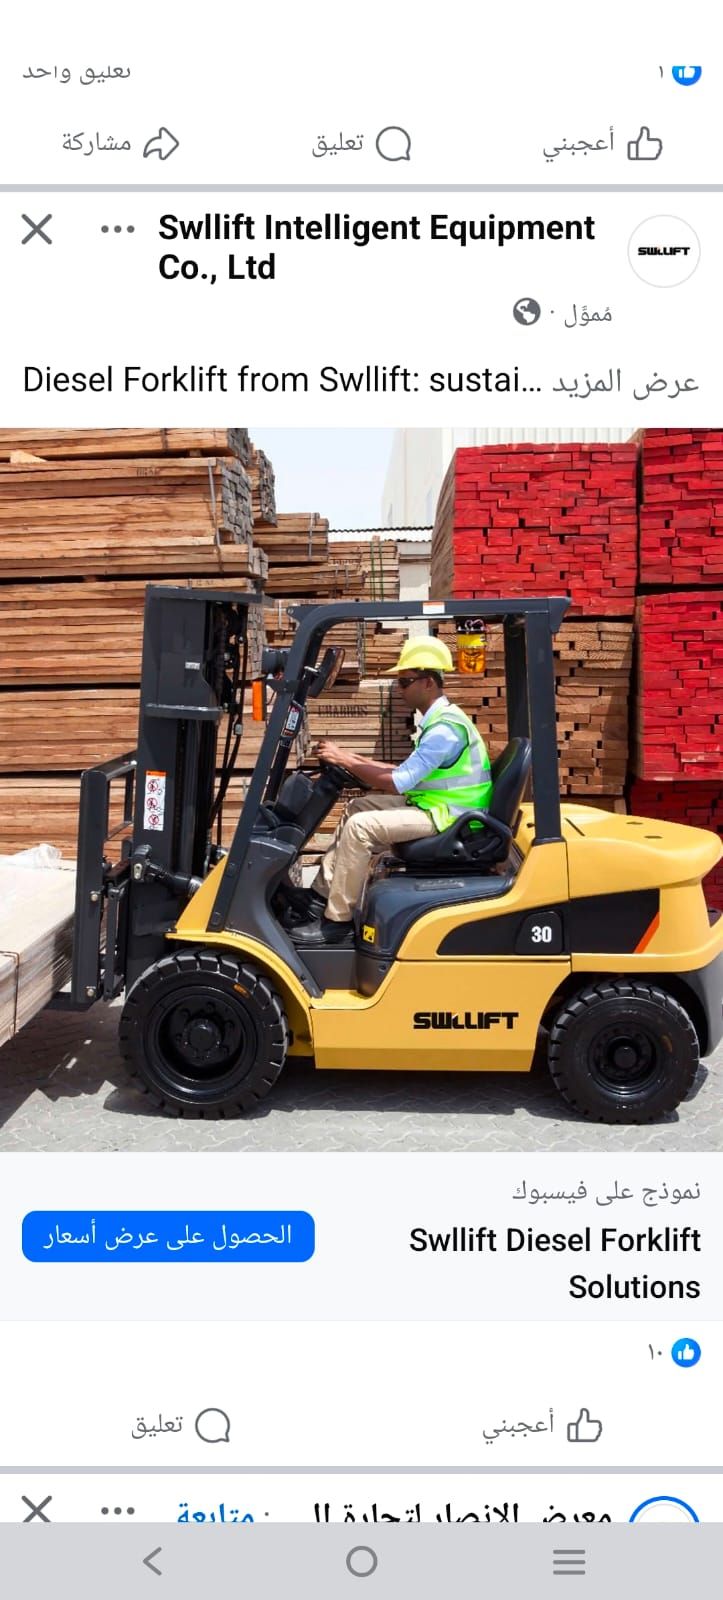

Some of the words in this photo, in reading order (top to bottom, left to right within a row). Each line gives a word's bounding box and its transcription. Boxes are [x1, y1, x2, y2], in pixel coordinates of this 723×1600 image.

[23, 66, 71, 84] واحد
[62, 131, 132, 157] مشاركة
[311, 131, 365, 159] تعليق
[542, 126, 614, 164] أعجبني
[158, 213, 256, 241] Swllift
[265, 213, 422, 248] Intelligent
[430, 213, 596, 248] Equipment
[158, 253, 217, 286] Co.,
[228, 252, 276, 280] Ltd
[23, 365, 112, 393] Diesel
[124, 365, 228, 393] Forklift
[236, 365, 309, 393] from
[319, 365, 420, 393] Swllift:
[552, 367, 622, 399] المزيد
[632, 371, 700, 401] عرض
[530, 925, 553, 944] 30
[511, 1179, 588, 1205] فيسبوك
[595, 1179, 634, 1207] على
[641, 1182, 701, 1208] نموذج
[42, 1216, 97, 1250] أسعار
[104, 1226, 160, 1253] عرض
[165, 1222, 206, 1253] على
[211, 1222, 292, 1253] الحصول
[409, 1226, 498, 1253] Swllift
[506, 1226, 591, 1253] Diesel
[601, 1226, 702, 1253] Forklift
[568, 1273, 701, 1300] Solutions
[131, 1413, 184, 1440] تعليق
[482, 1408, 554, 1446] أعجبني
